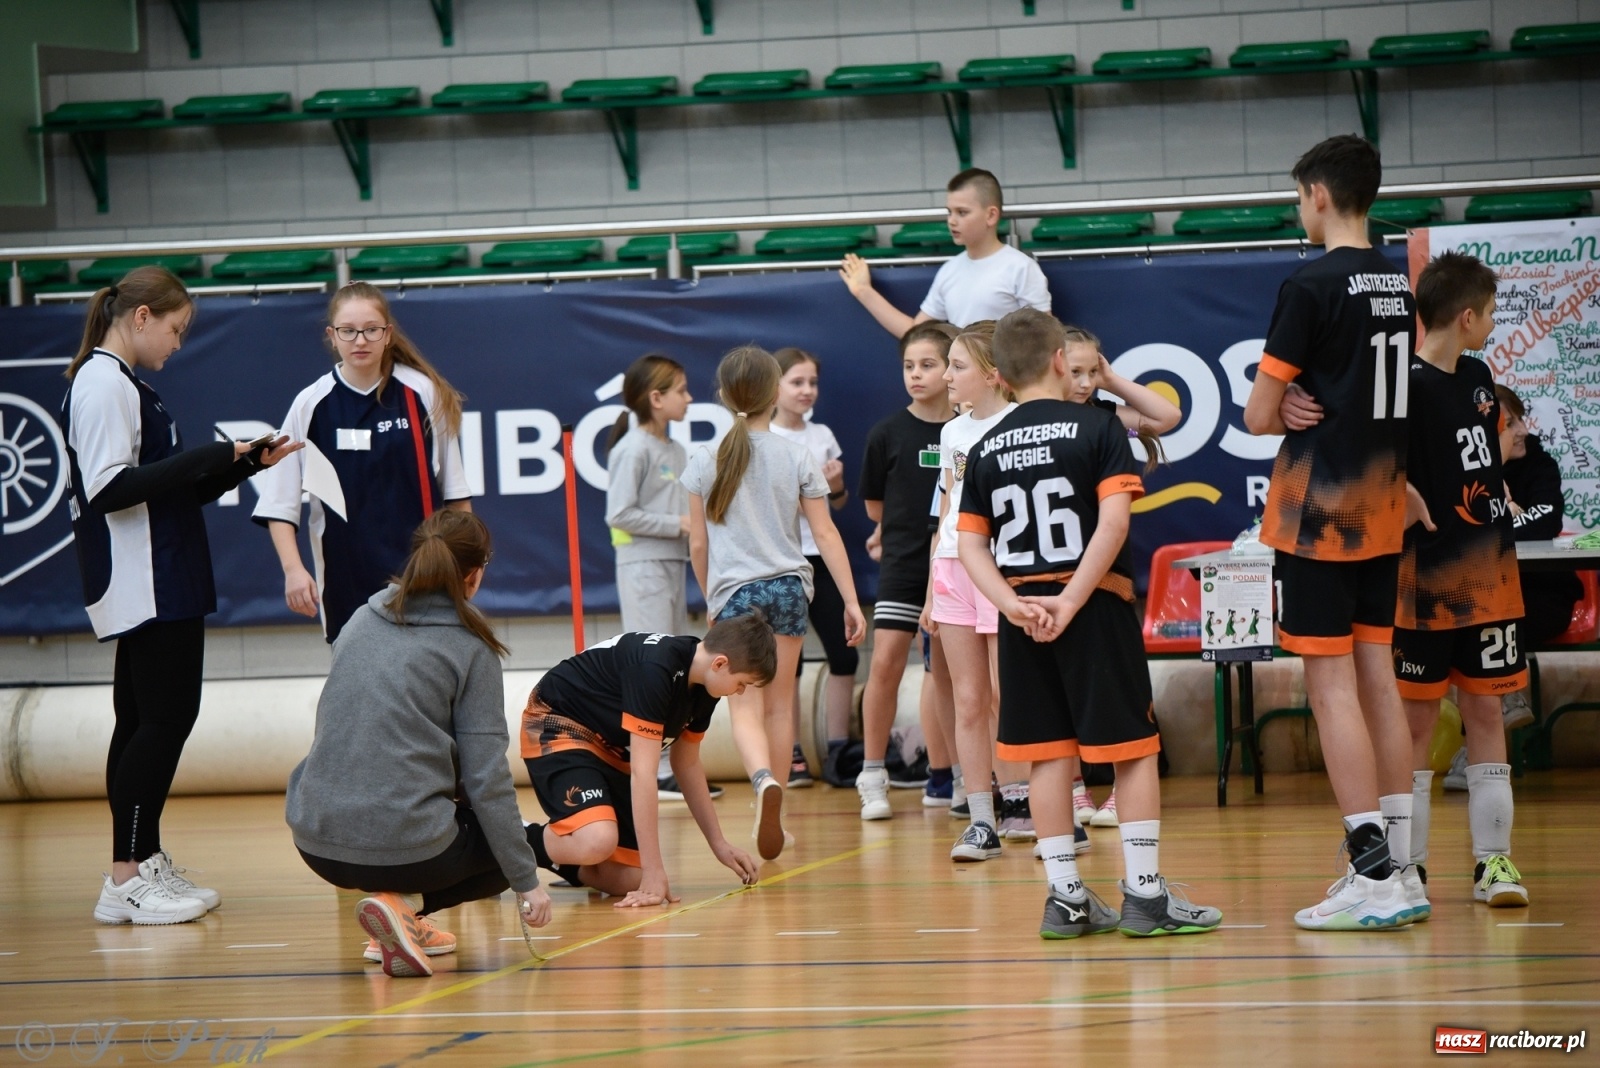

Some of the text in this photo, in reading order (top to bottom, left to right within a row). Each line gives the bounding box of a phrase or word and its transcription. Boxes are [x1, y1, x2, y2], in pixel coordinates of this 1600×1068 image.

[1370, 297, 1409, 319] WĘGIEL
[1370, 331, 1409, 420] 11
[377, 417, 409, 433] SP 18
[979, 422, 1079, 459] JASTRZĘBSKI
[1455, 424, 1492, 472] 28
[996, 445, 1054, 472] WĘGIEL
[991, 476, 1084, 568] 26
[1232, 574, 1267, 582] PODANIE
[1479, 622, 1518, 670] 28
[1400, 660, 1425, 676] JSW
[580, 788, 603, 804] JSW
[126, 896, 141, 909] FILA
